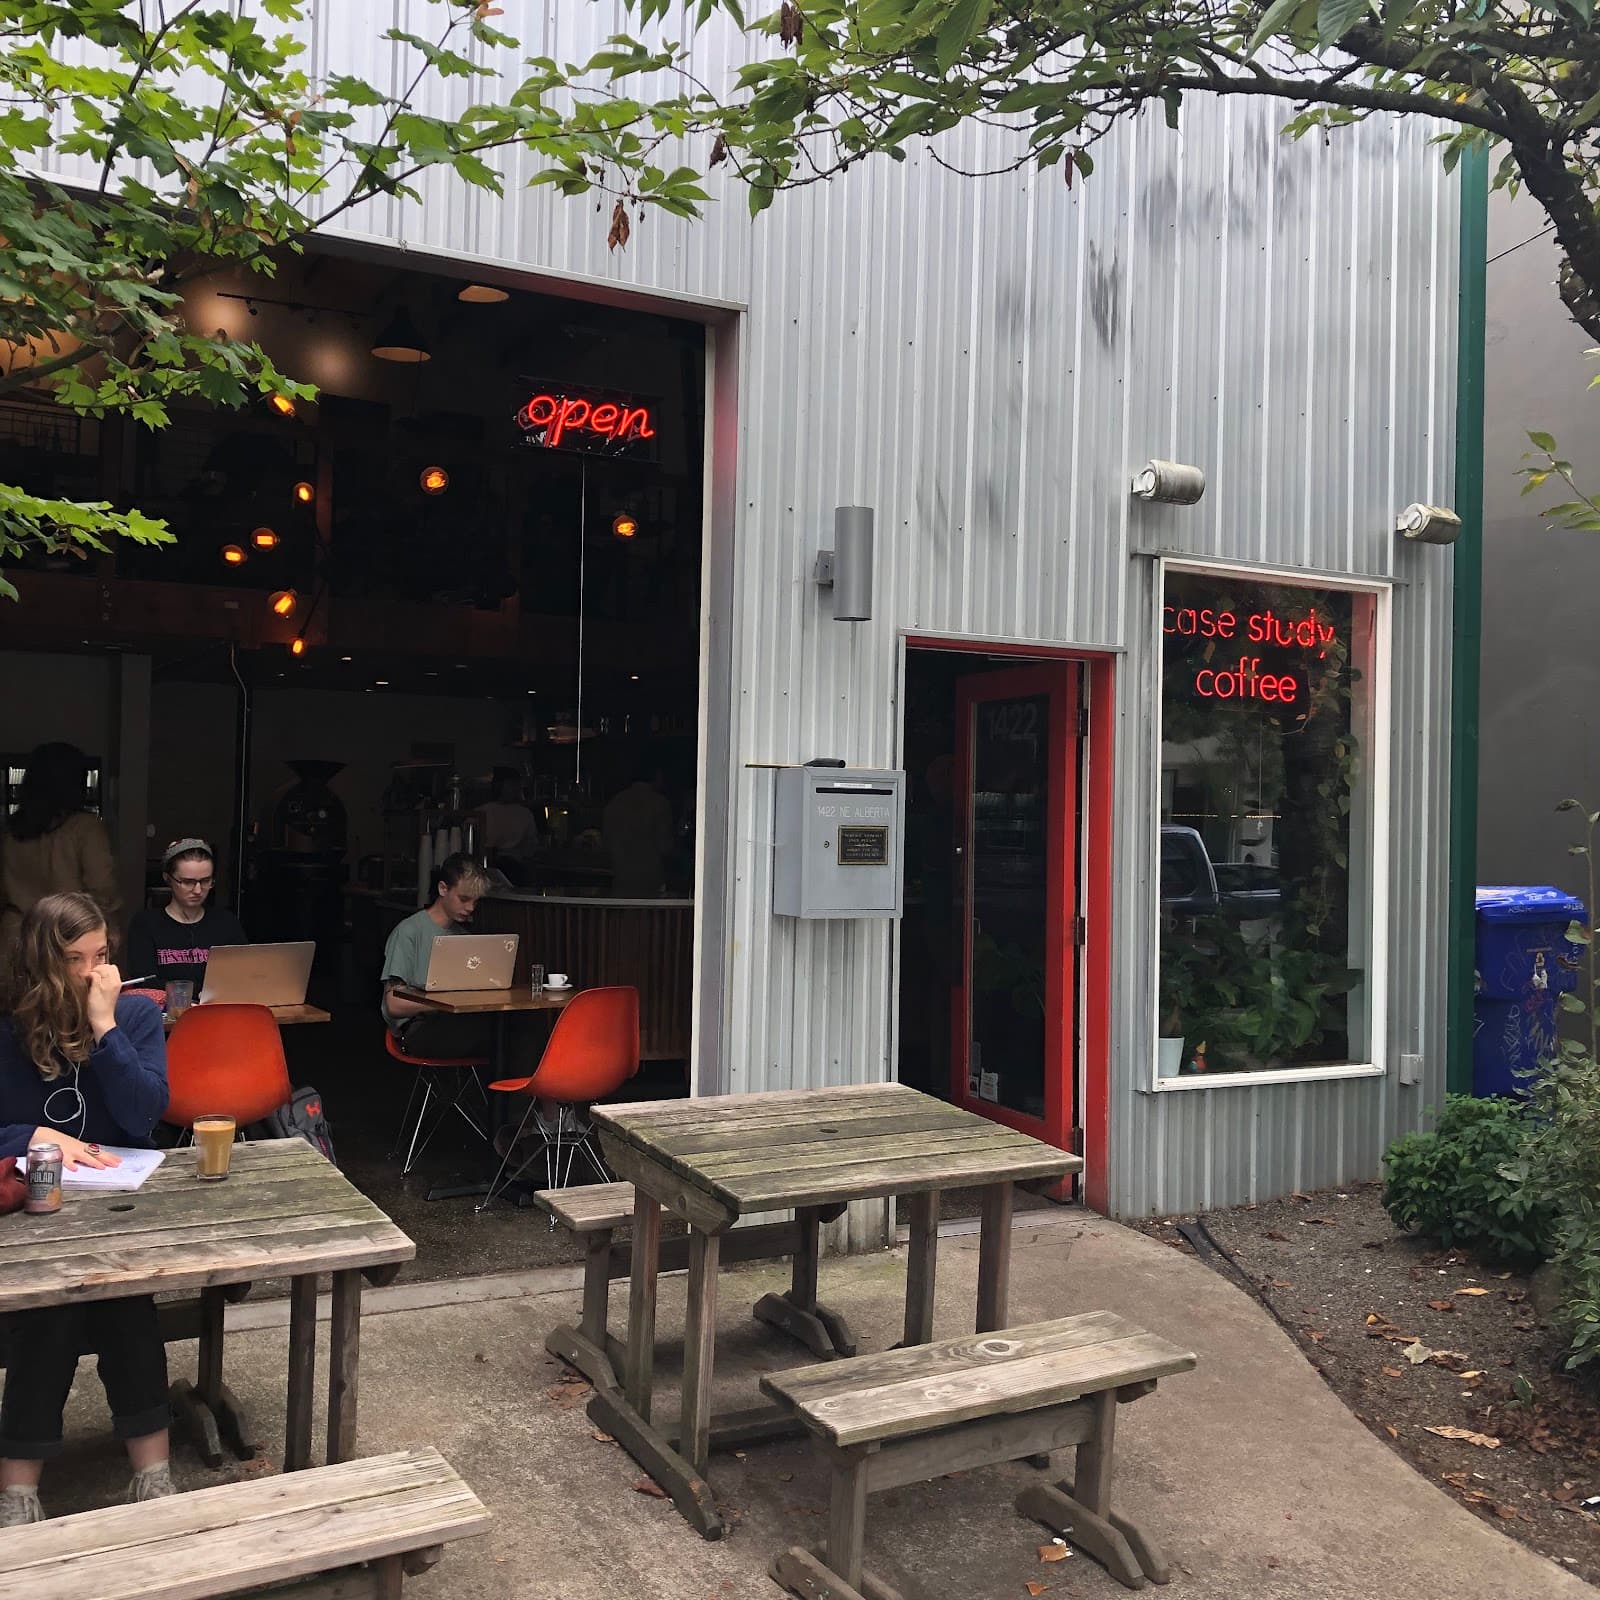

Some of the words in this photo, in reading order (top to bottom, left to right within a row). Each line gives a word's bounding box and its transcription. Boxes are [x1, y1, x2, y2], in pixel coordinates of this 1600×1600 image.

[528, 395, 655, 447] open
[1162, 604, 1236, 638] case
[1247, 608, 1337, 659] study
[1196, 656, 1297, 702] coffee
[987, 703, 1041, 743] 1422
[817, 806, 836, 817] 1422
[840, 806, 851, 818] NE
[855, 806, 890, 818] ALBERTA
[30, 1172, 54, 1185] POLAR
